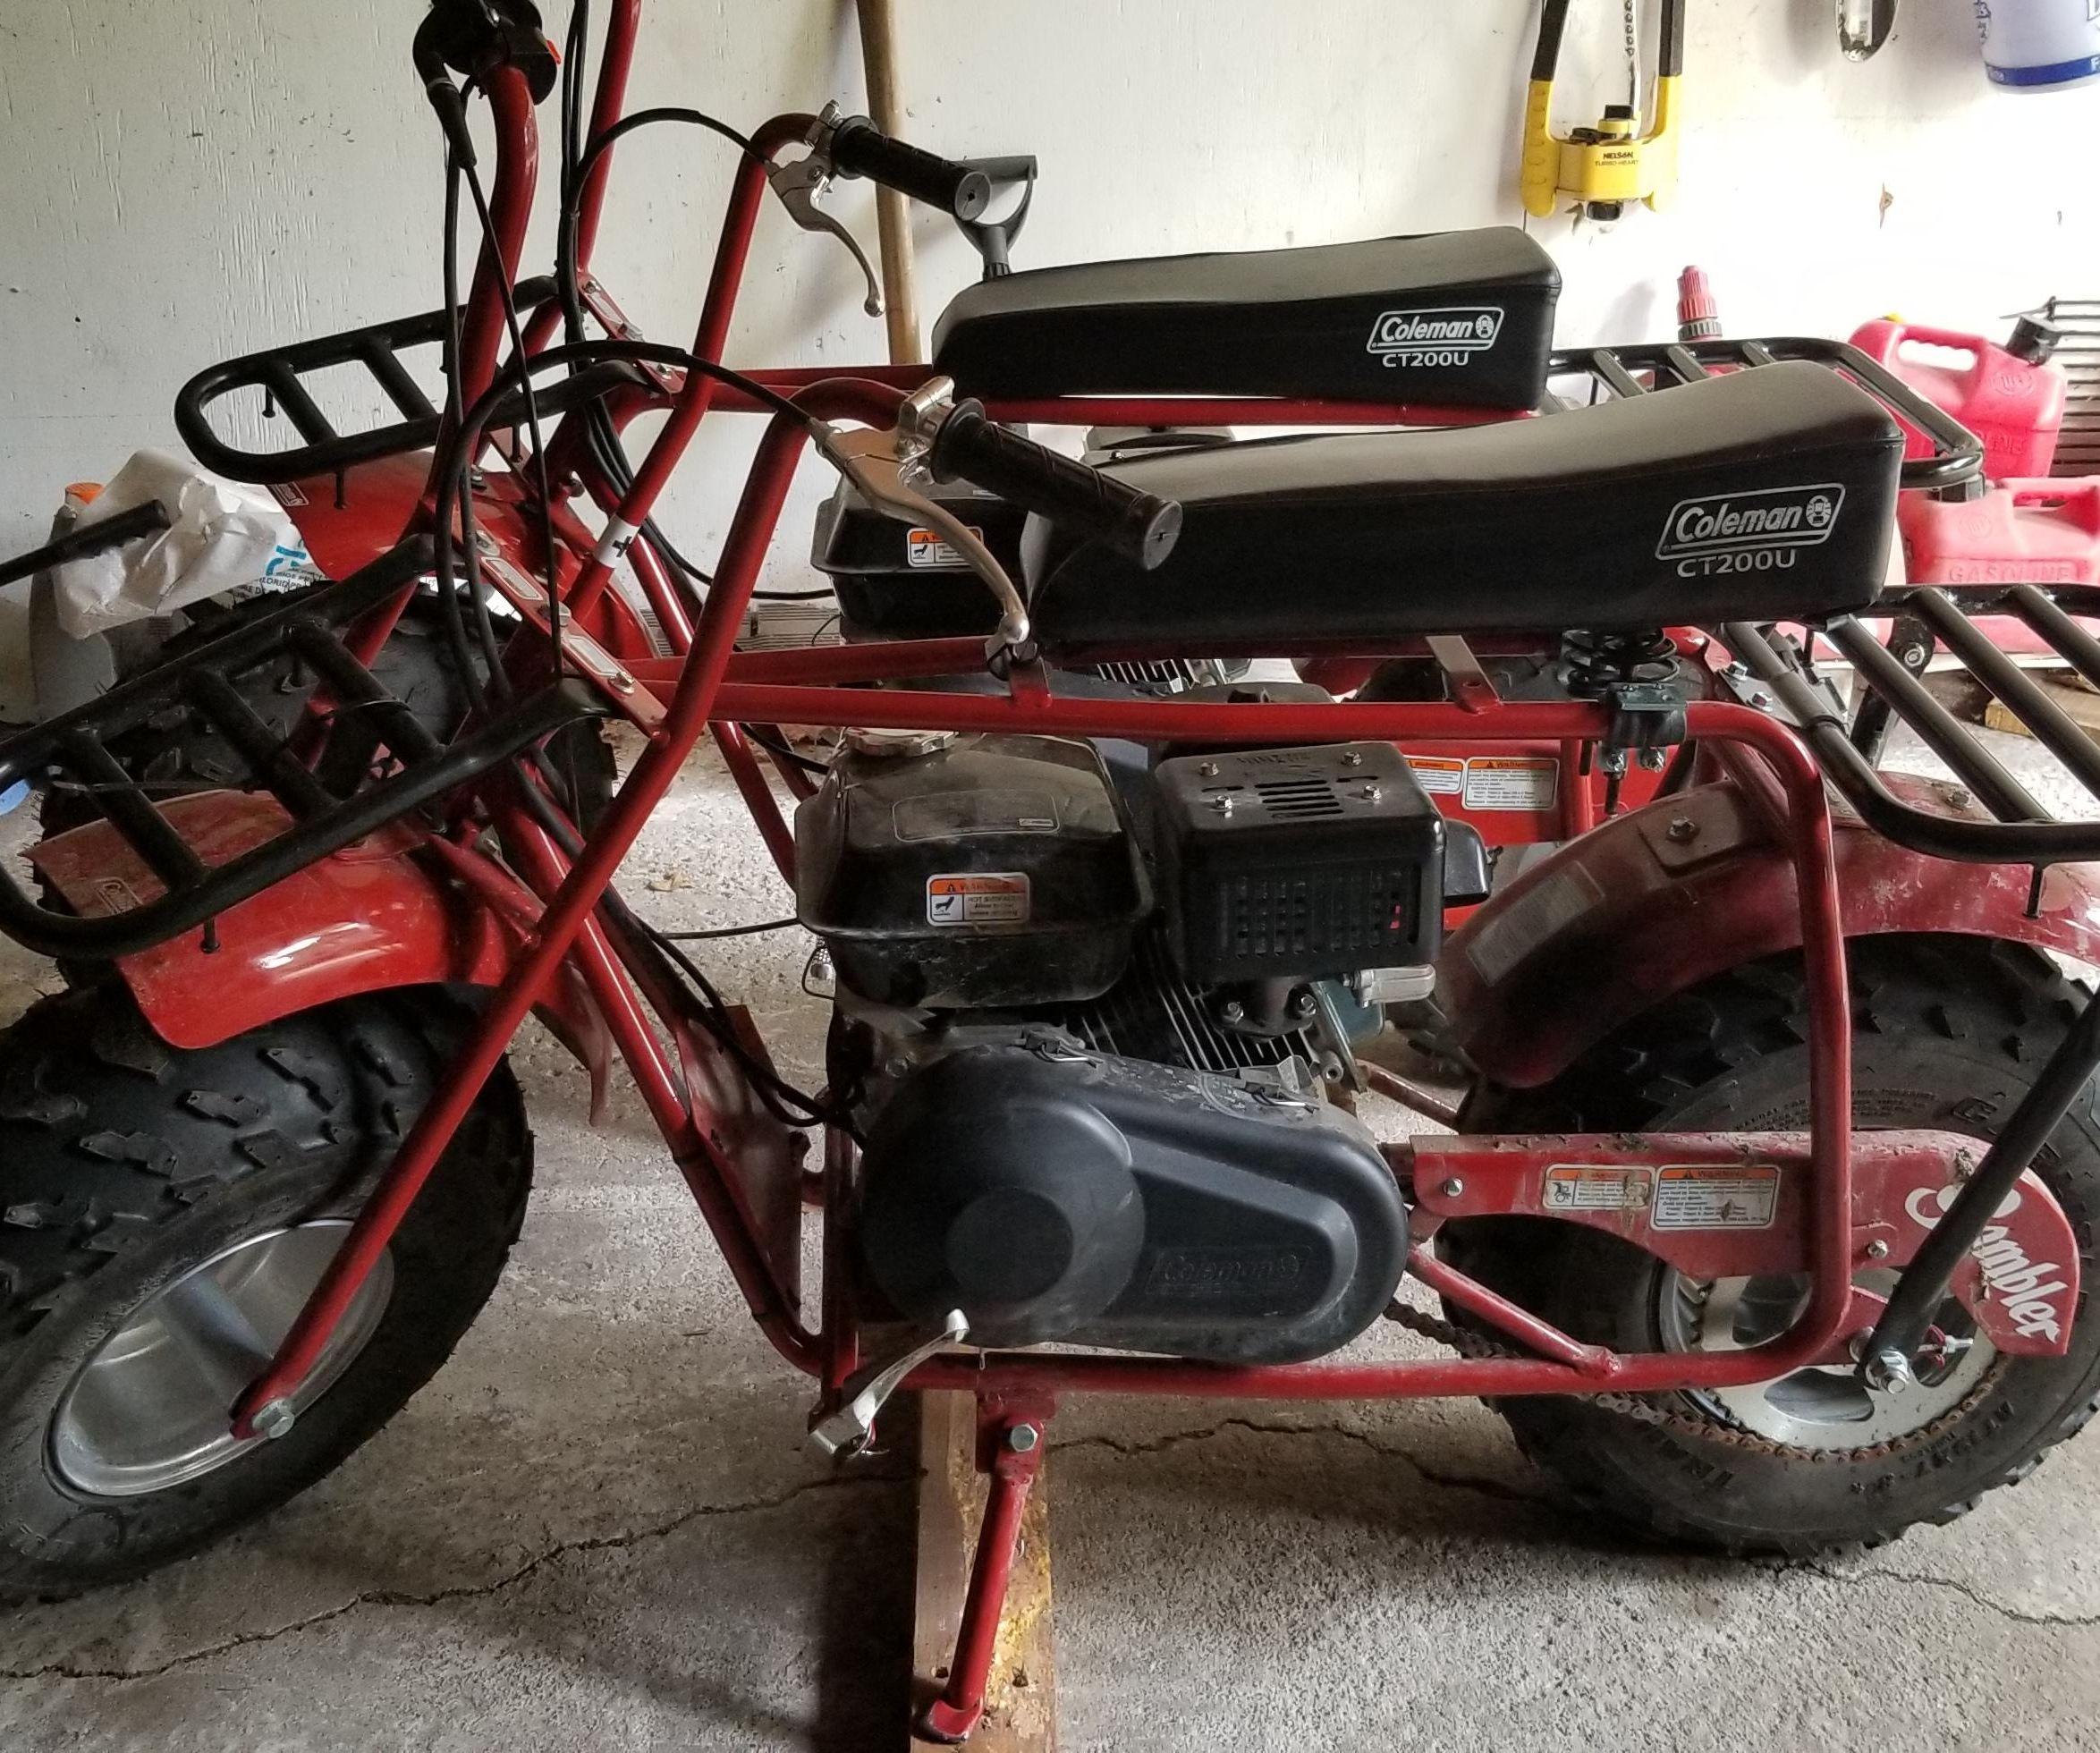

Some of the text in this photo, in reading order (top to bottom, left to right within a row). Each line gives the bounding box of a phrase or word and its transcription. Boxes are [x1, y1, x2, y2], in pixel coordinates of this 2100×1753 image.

[1381, 315, 1474, 343] Coleman
[1382, 351, 1469, 368] CT200U
[1675, 502, 1803, 543] Coleman
[1676, 548, 1797, 578] CT200U
